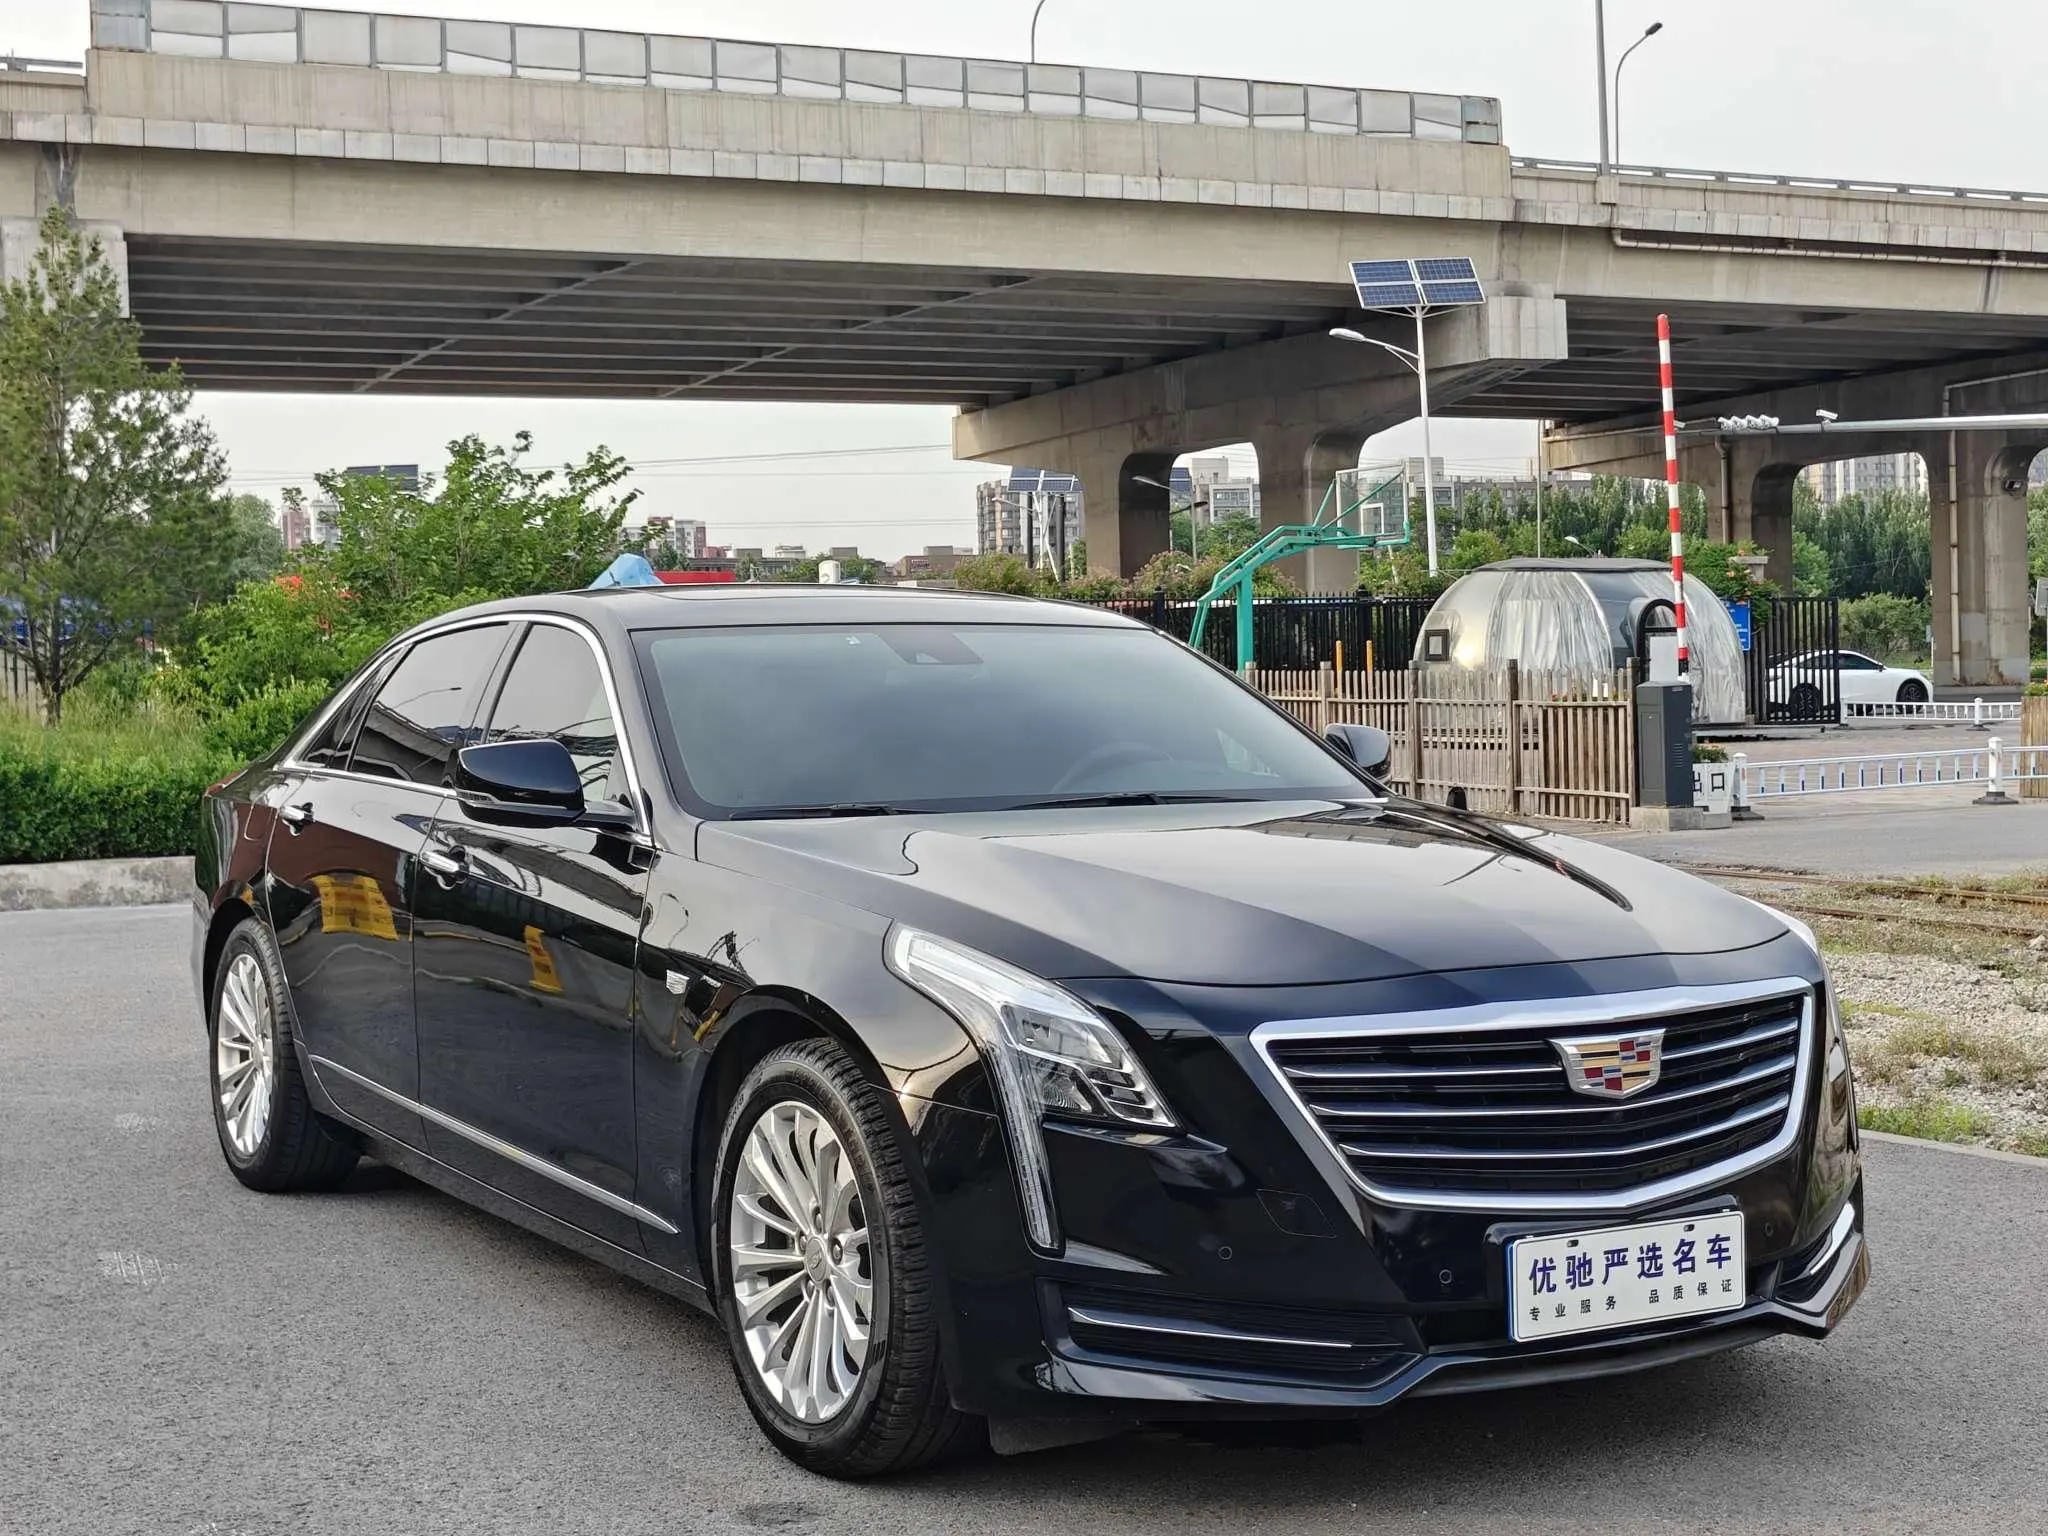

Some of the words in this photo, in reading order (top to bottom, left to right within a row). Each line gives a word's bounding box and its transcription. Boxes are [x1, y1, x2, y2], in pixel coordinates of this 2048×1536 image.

[1528, 1233, 1732, 1295] 优驰严选名车
[1529, 1295, 1617, 1321] 专业服务
[1649, 1278, 1733, 1304] 品质保证
